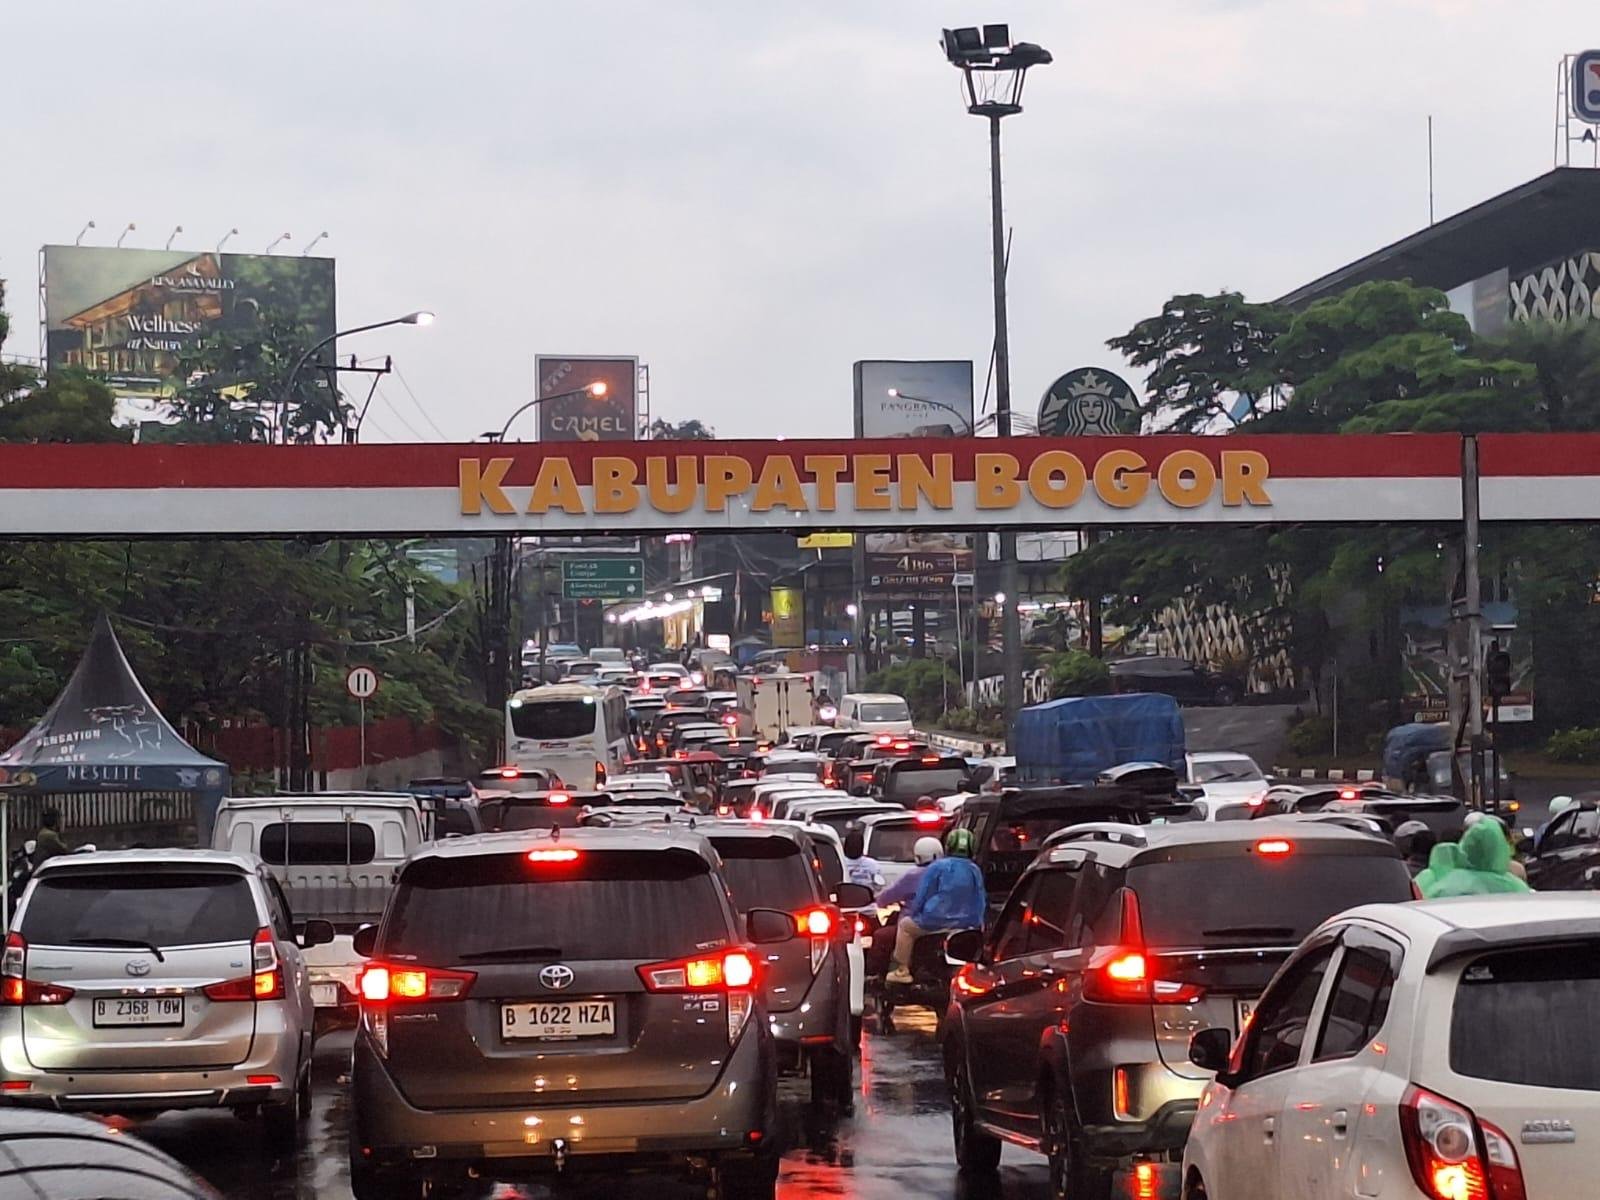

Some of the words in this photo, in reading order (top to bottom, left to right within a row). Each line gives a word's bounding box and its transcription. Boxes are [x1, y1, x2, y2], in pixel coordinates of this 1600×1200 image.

[551, 416, 627, 432] CAMEL
[458, 453, 954, 515] KABUPATEN
[975, 449, 1273, 509] BOGOR
[36, 729, 100, 746] SENSATION
[67, 766, 142, 780] NESLITE
[117, 1001, 148, 1015] 2368
[506, 1008, 515, 1025] B
[529, 1006, 571, 1025] 1622
[579, 1005, 611, 1023] HZA
